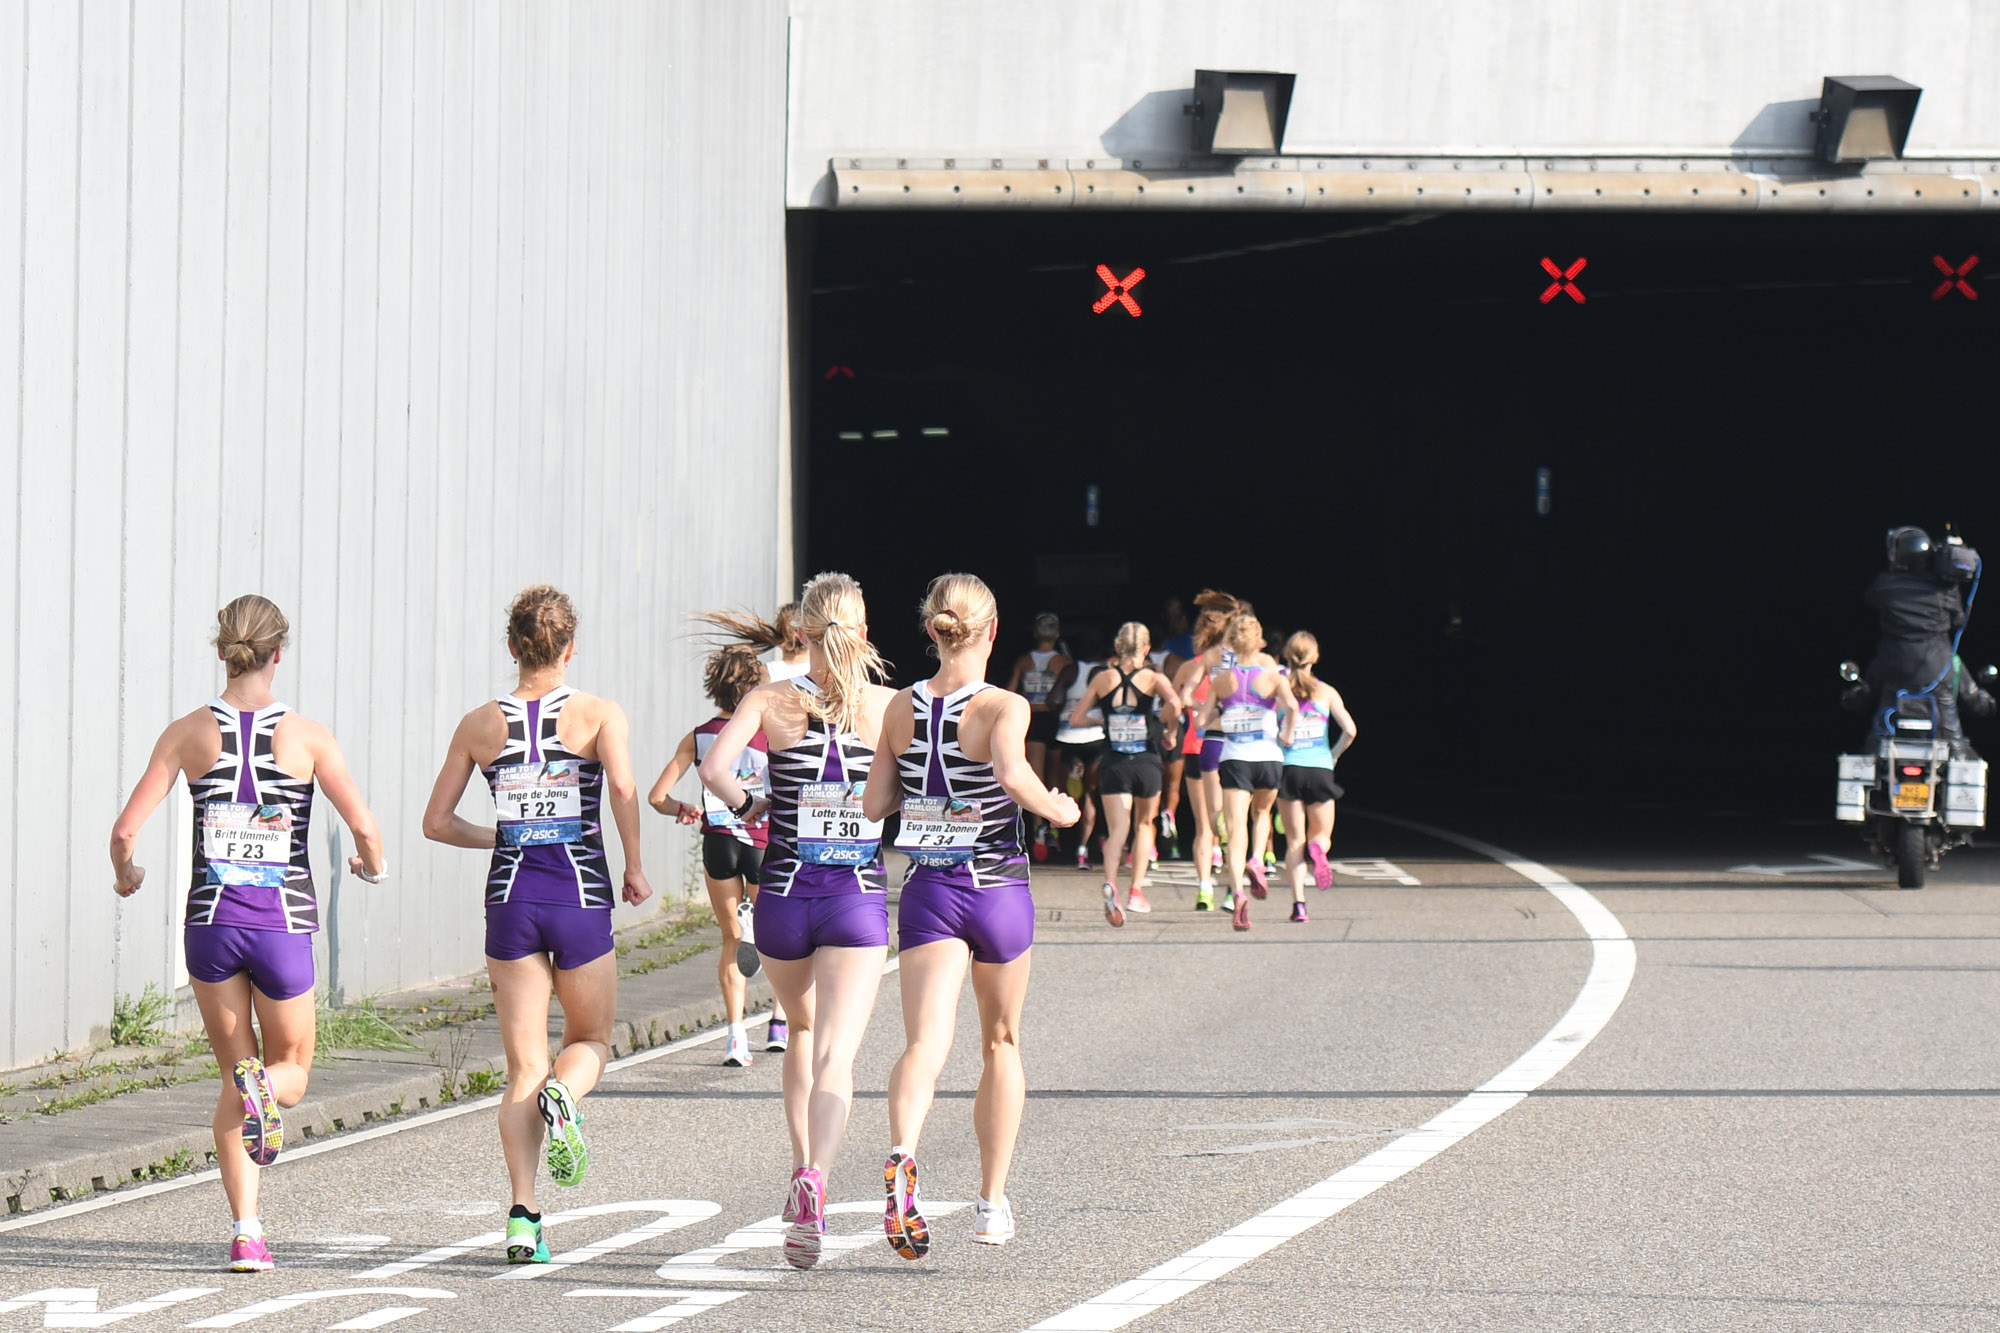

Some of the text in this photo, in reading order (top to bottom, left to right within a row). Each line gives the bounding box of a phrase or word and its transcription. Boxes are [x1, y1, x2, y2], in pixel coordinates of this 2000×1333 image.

[499, 765, 535, 775] DAM TOT
[499, 772, 539, 781] DAMLOOP
[507, 789, 569, 802] Inge de Jong
[208, 803, 228, 811] DAM
[520, 802, 556, 818] F 22
[904, 803, 942, 811] DAMLOOP
[811, 809, 836, 818] Lotte
[823, 821, 860, 838] F 30
[906, 821, 978, 833] Eva van Zoonen
[214, 829, 279, 842] Britt Ummels
[918, 834, 955, 846] F 34
[227, 843, 264, 859] F 23
